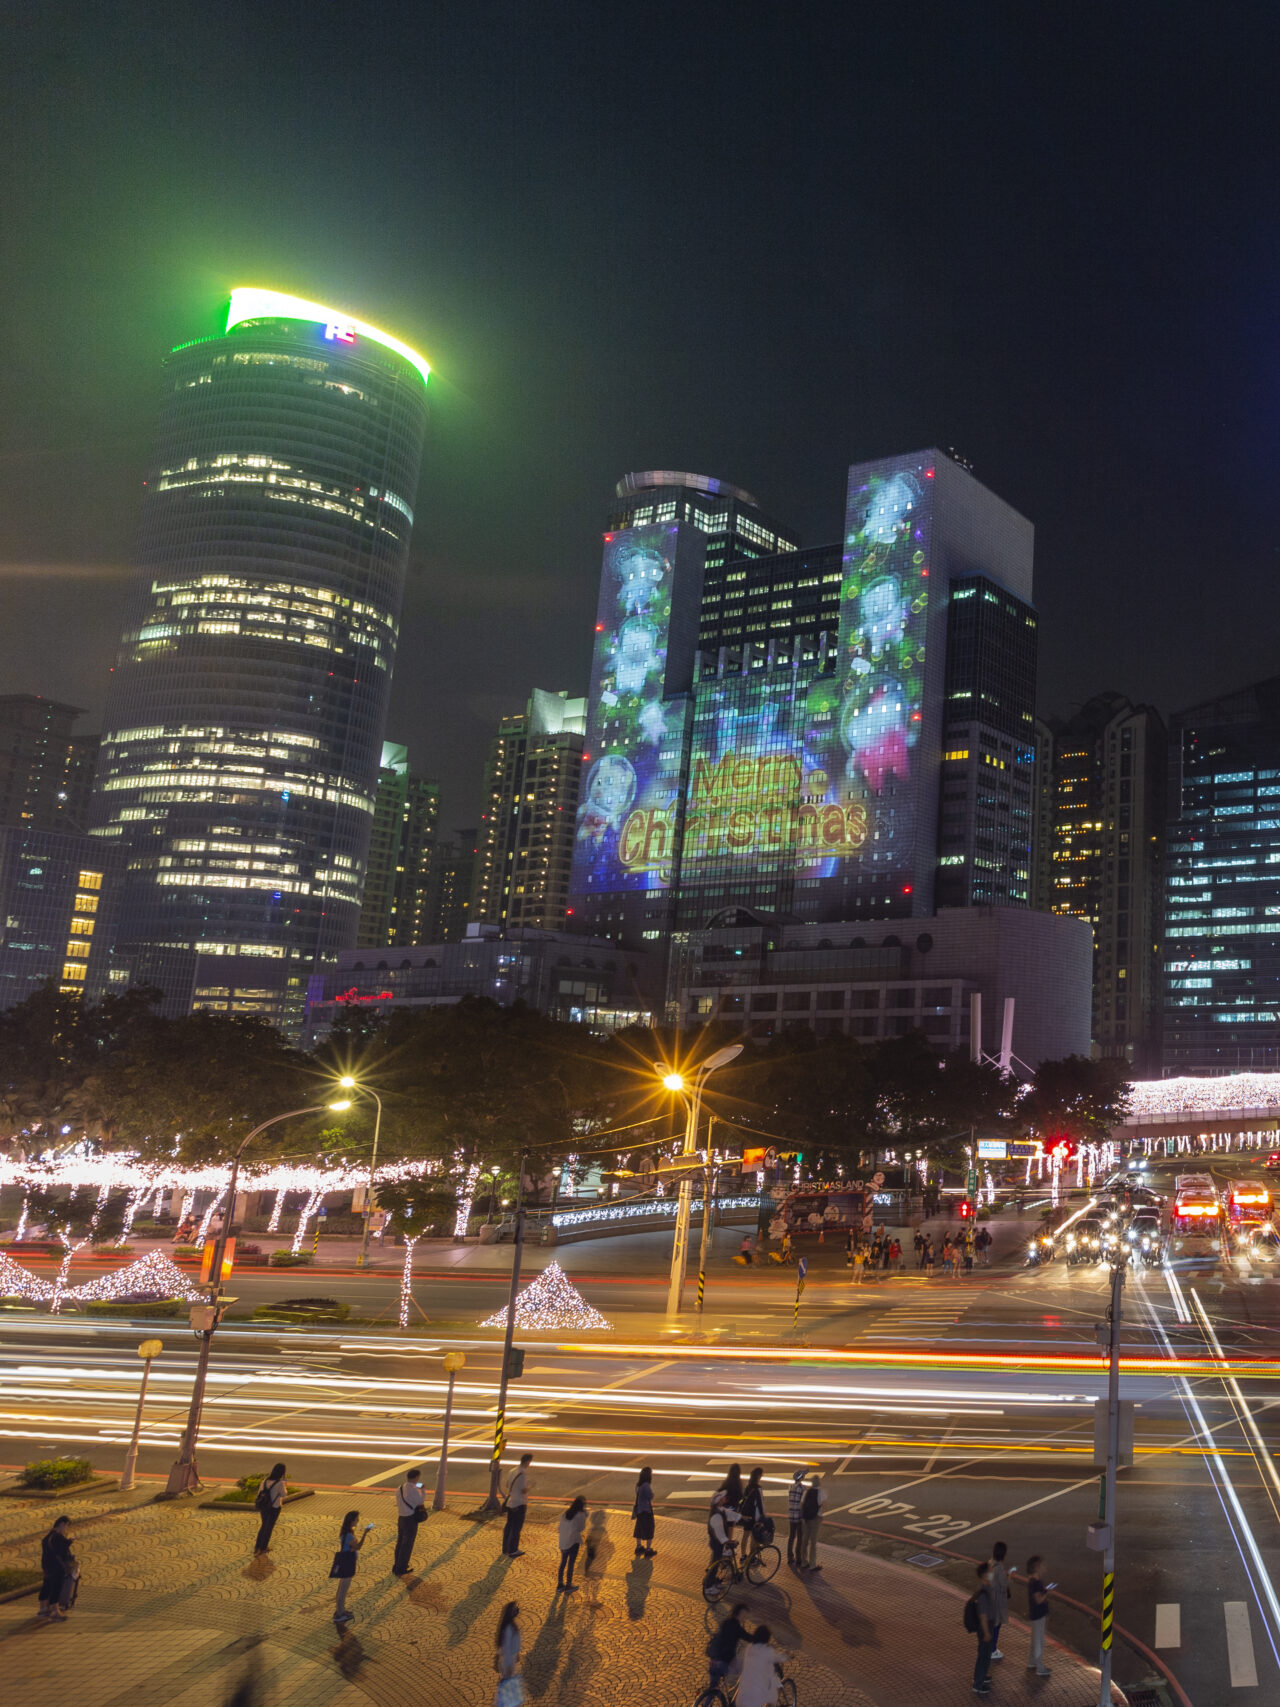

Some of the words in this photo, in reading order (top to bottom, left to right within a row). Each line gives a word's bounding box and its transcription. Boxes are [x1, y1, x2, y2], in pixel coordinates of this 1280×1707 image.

[691, 750, 802, 796] Merry
[619, 800, 868, 865] Christmas
[848, 1498, 972, 1539] 07-22
